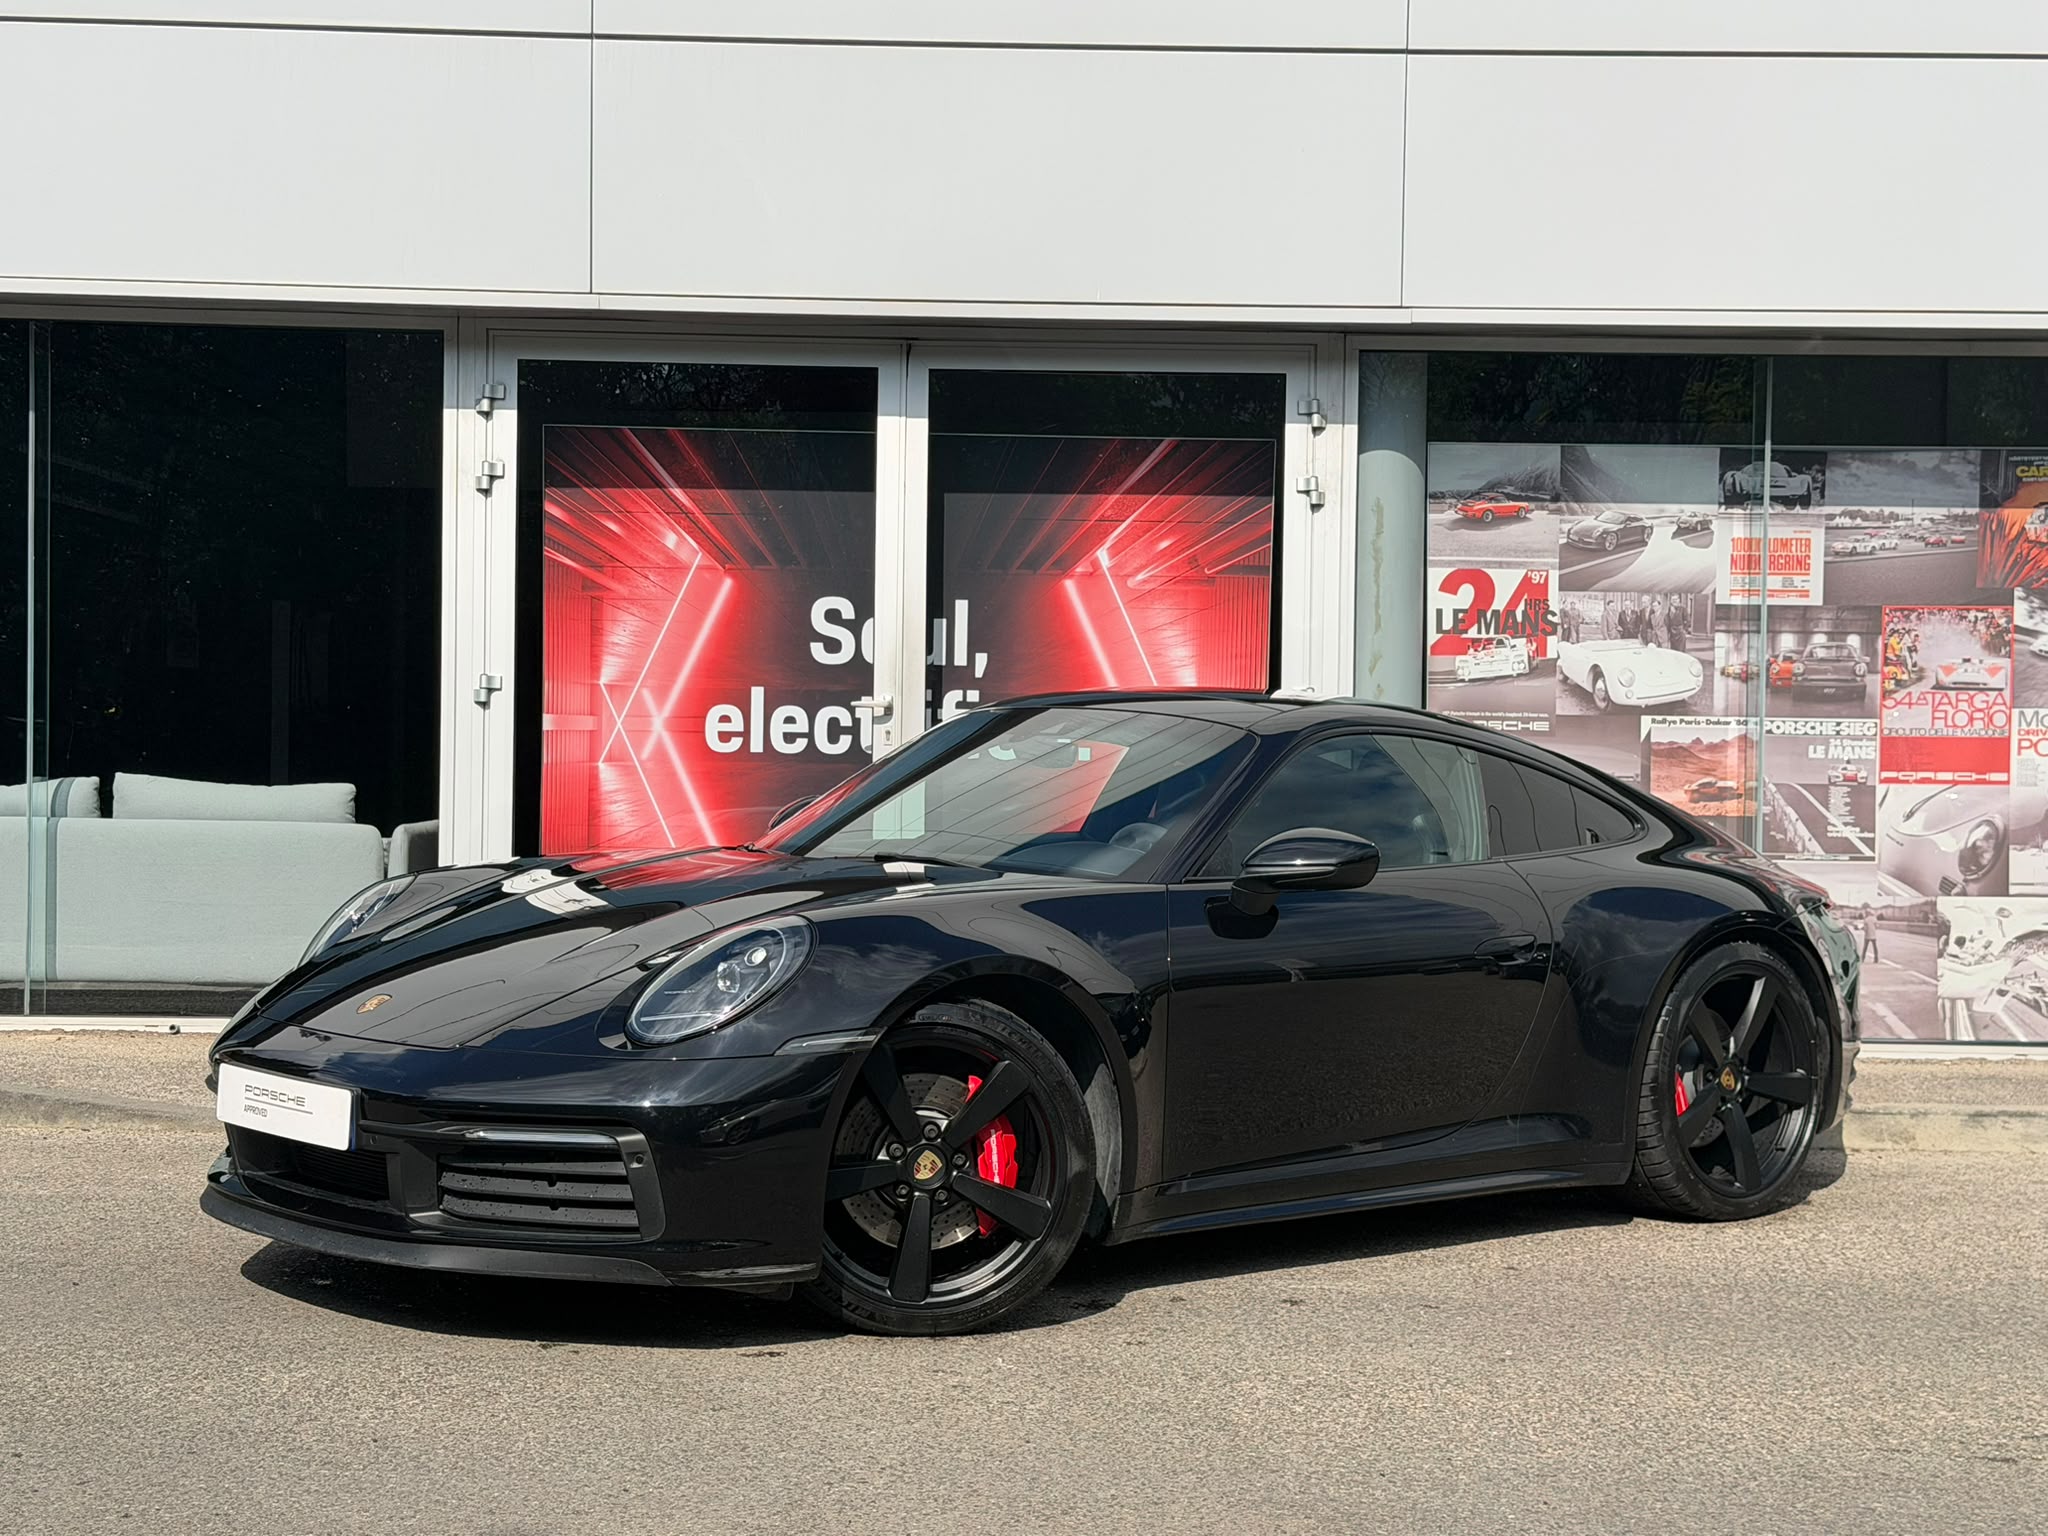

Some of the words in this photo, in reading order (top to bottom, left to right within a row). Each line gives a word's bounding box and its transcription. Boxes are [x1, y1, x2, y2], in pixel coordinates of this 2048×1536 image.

[1755, 537, 1811, 553] KLOMETER
[1527, 571, 1547, 584] '97
[1524, 598, 1550, 610] HRS
[1435, 608, 1469, 635] LE
[1476, 608, 1558, 637] MANS
[1922, 691, 2009, 710] TARGA
[1931, 709, 2009, 729] FLORIO
[1808, 745, 1826, 758] LE
[1828, 746, 1876, 759] MANS
[1880, 771, 2009, 781] PORSCHE
[244, 1084, 306, 1107] PORSCHE
[244, 1104, 268, 1118] APPROVED
